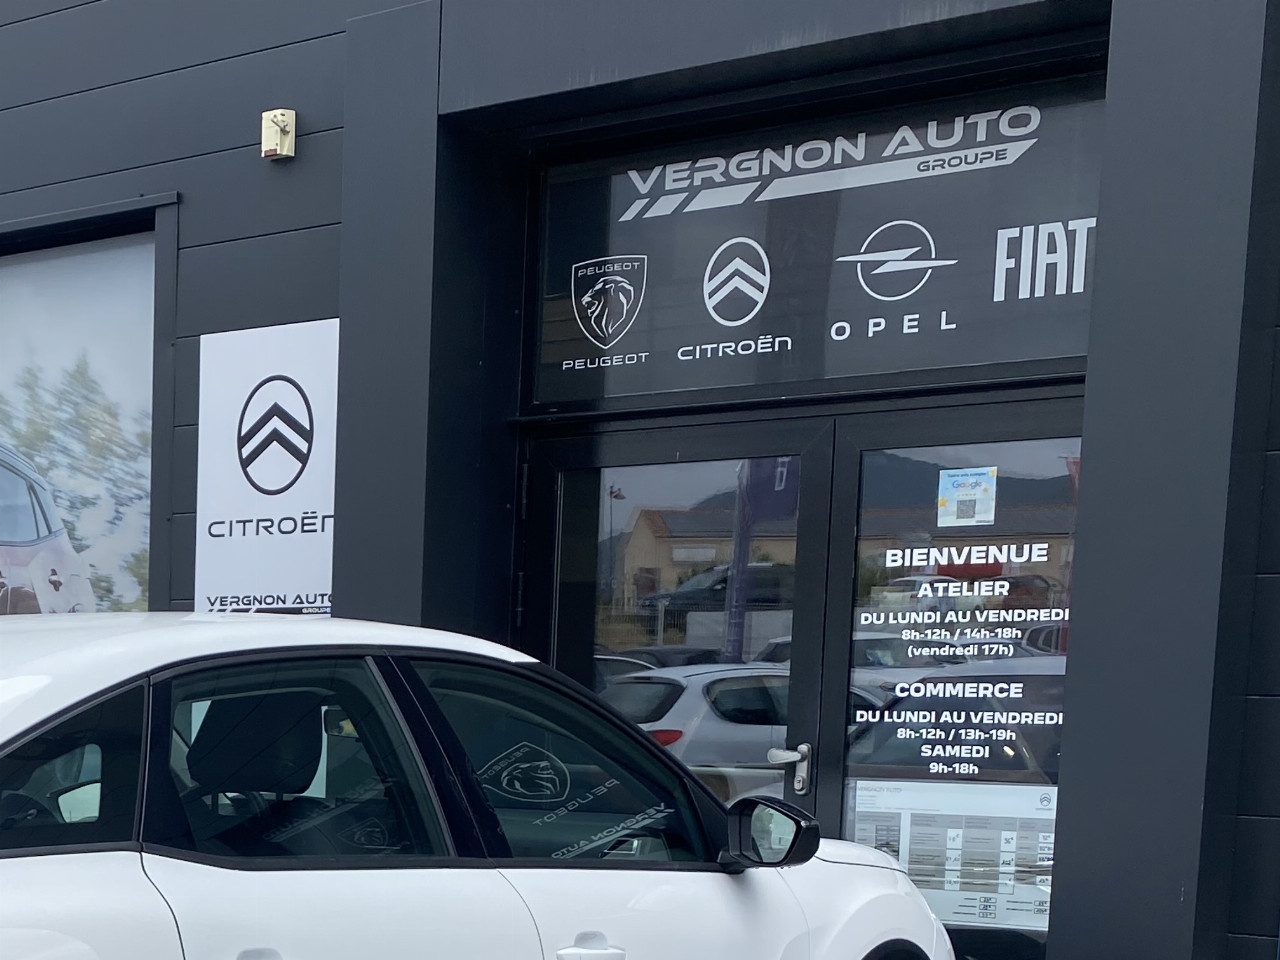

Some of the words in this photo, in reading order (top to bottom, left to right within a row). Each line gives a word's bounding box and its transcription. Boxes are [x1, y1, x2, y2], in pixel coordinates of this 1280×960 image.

[627, 132, 866, 194] VERGNON
[881, 105, 1041, 157] AUTO
[916, 148, 1009, 173] GROUPE
[993, 216, 1097, 302] FIAT
[577, 262, 640, 278] PEUGEOT
[562, 352, 650, 371] PEUGEOT
[952, 480, 983, 490] Google
[885, 542, 1049, 568] BIENVENUE
[916, 580, 1010, 598] ATELIER
[206, 594, 287, 607] VERGNON
[291, 593, 332, 605] AUT
[860, 612, 885, 625] DU
[888, 611, 941, 624] LUNDI
[944, 610, 971, 623] AU
[974, 608, 1070, 622] VENDREDI
[901, 628, 951, 641] 8h-12h
[963, 627, 1022, 640] 14h-18h
[907, 644, 978, 658] (vendredi
[981, 644, 1014, 657] 17h)
[895, 682, 1024, 699] COMMERCE
[855, 710, 881, 723] DU
[884, 710, 936, 723] LUNDI
[939, 711, 966, 723] AU
[969, 711, 1064, 725] VENDREDI
[896, 728, 946, 740] 8h-12h
[958, 729, 1016, 741] 13h-19h
[920, 745, 990, 758] SAMEDI
[928, 763, 979, 775] 9h-18h
